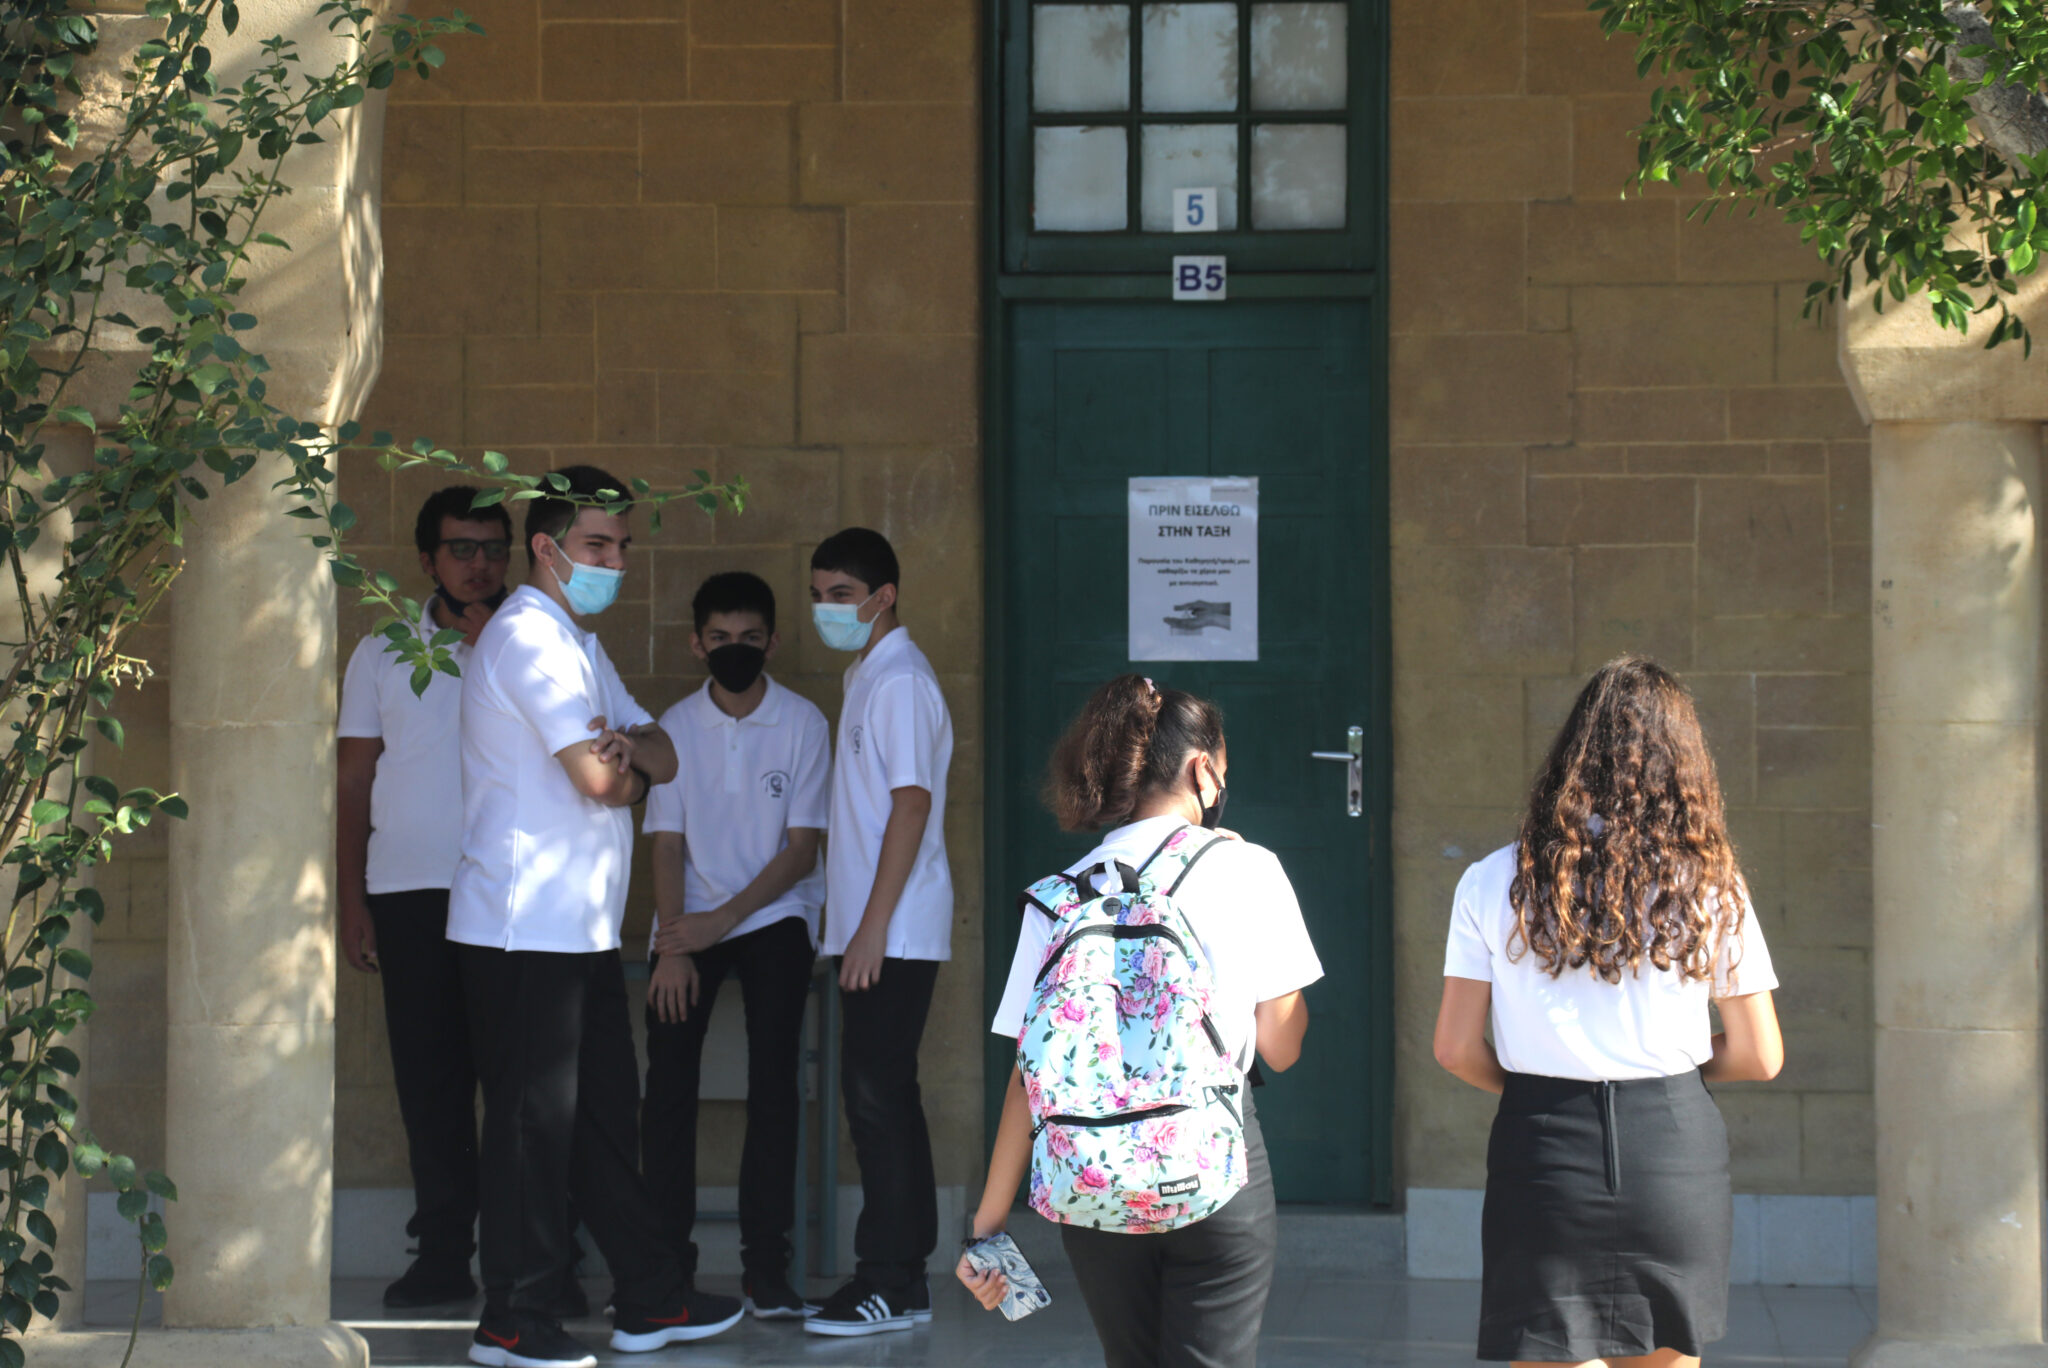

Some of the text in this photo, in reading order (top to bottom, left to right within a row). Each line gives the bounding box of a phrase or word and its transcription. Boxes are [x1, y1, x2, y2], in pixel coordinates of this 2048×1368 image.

[1187, 194, 1204, 226] 5
[1179, 265, 1223, 292] B5
[1149, 504, 1241, 516] ΠΡΙΝ ΕΙΣΕΛΘΩ
[1158, 526, 1231, 537] ΣΤΗΝ ΤΑΞΗ
